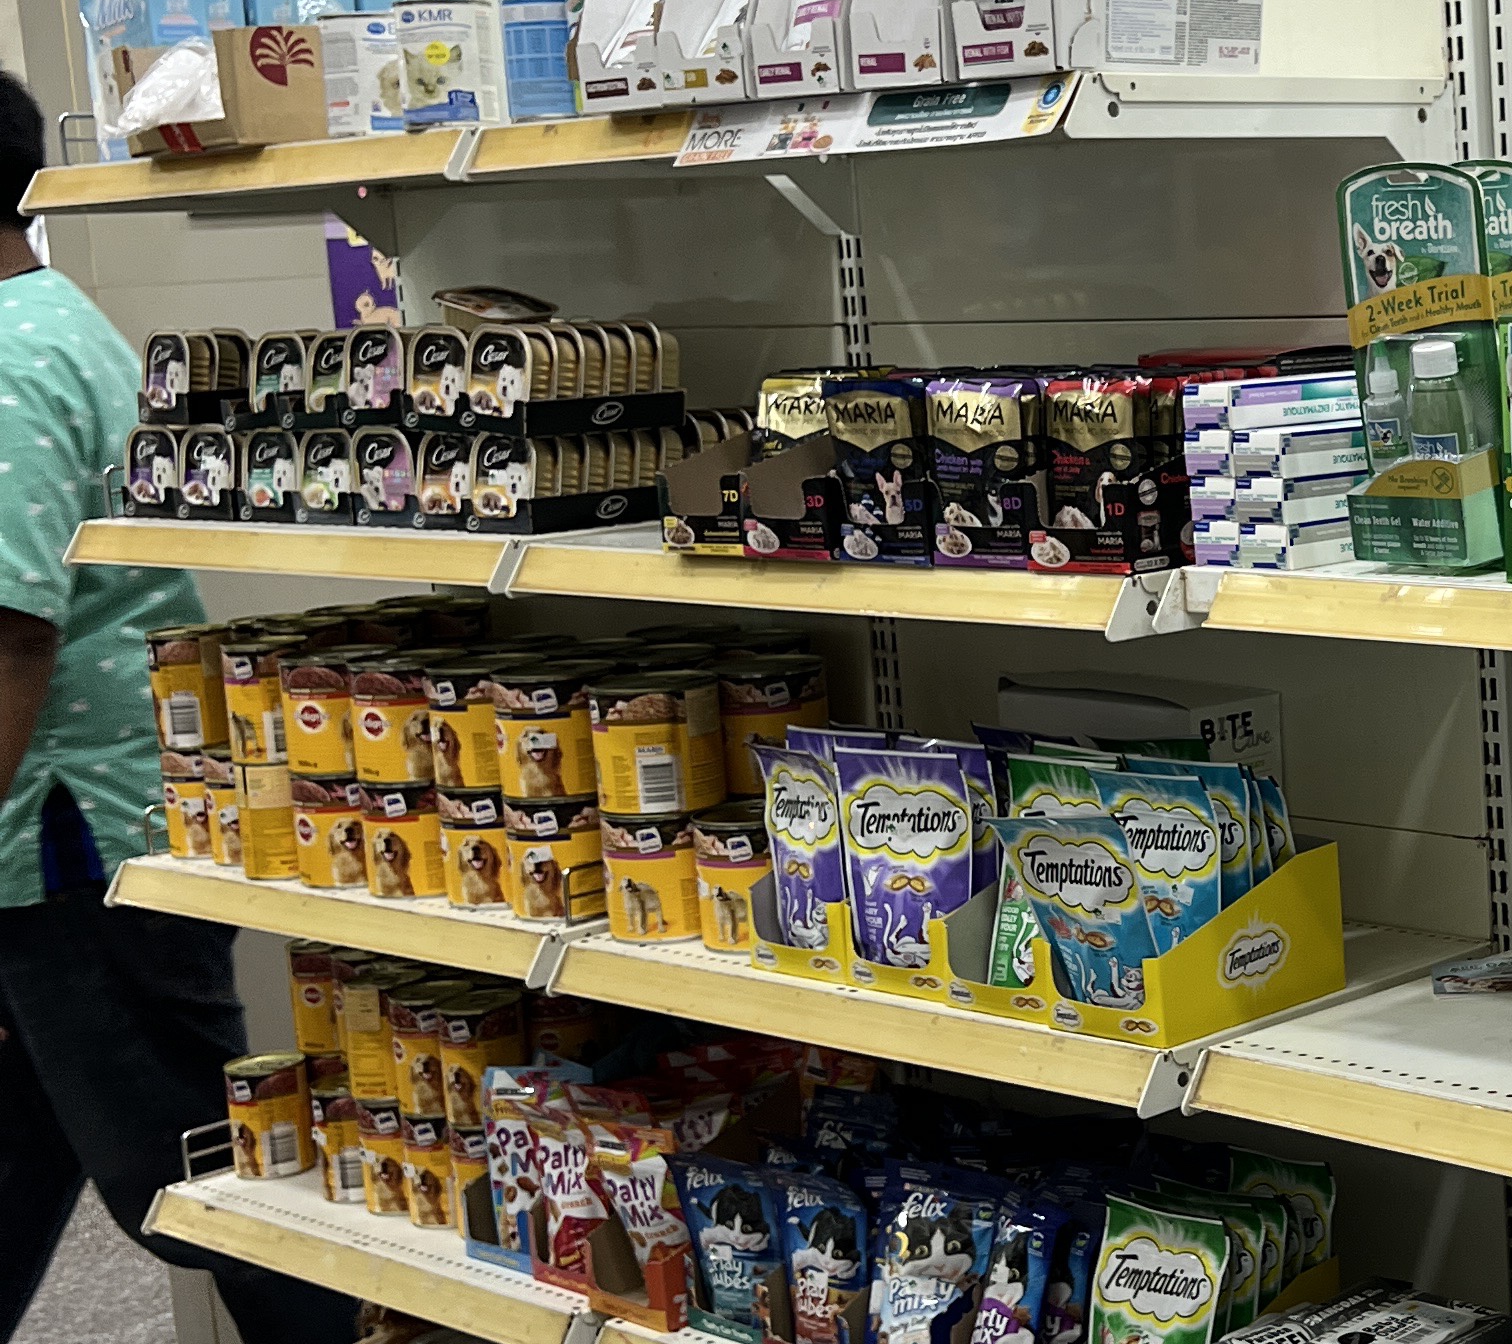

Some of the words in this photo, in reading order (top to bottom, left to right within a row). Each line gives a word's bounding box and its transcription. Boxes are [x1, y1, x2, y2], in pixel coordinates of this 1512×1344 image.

[417, 7, 452, 24] KMR
[689, 129, 742, 151] MORE
[1371, 192, 1422, 220] fresh
[1374, 213, 1452, 241] breath
[1366, 290, 1423, 323] 2-Week
[1427, 281, 1465, 304] Trial
[834, 400, 896, 424] MARIA
[936, 400, 1004, 427] MARIA
[1053, 399, 1118, 425] MARIA
[722, 490, 738, 502] 7D
[806, 495, 824, 507] 3D
[1003, 497, 1022, 510] 8D
[1107, 503, 1125, 516] 1D
[1097, 536, 1124, 546] MARIA
[857, 801, 961, 839] Temptations
[1023, 850, 1127, 893] Temptations
[1228, 937, 1281, 976] Temptations
[544, 1170, 584, 1197] Mix
[607, 1174, 657, 1207] Party
[625, 1202, 664, 1229] Mix
[1105, 1254, 1206, 1301] Temptations
